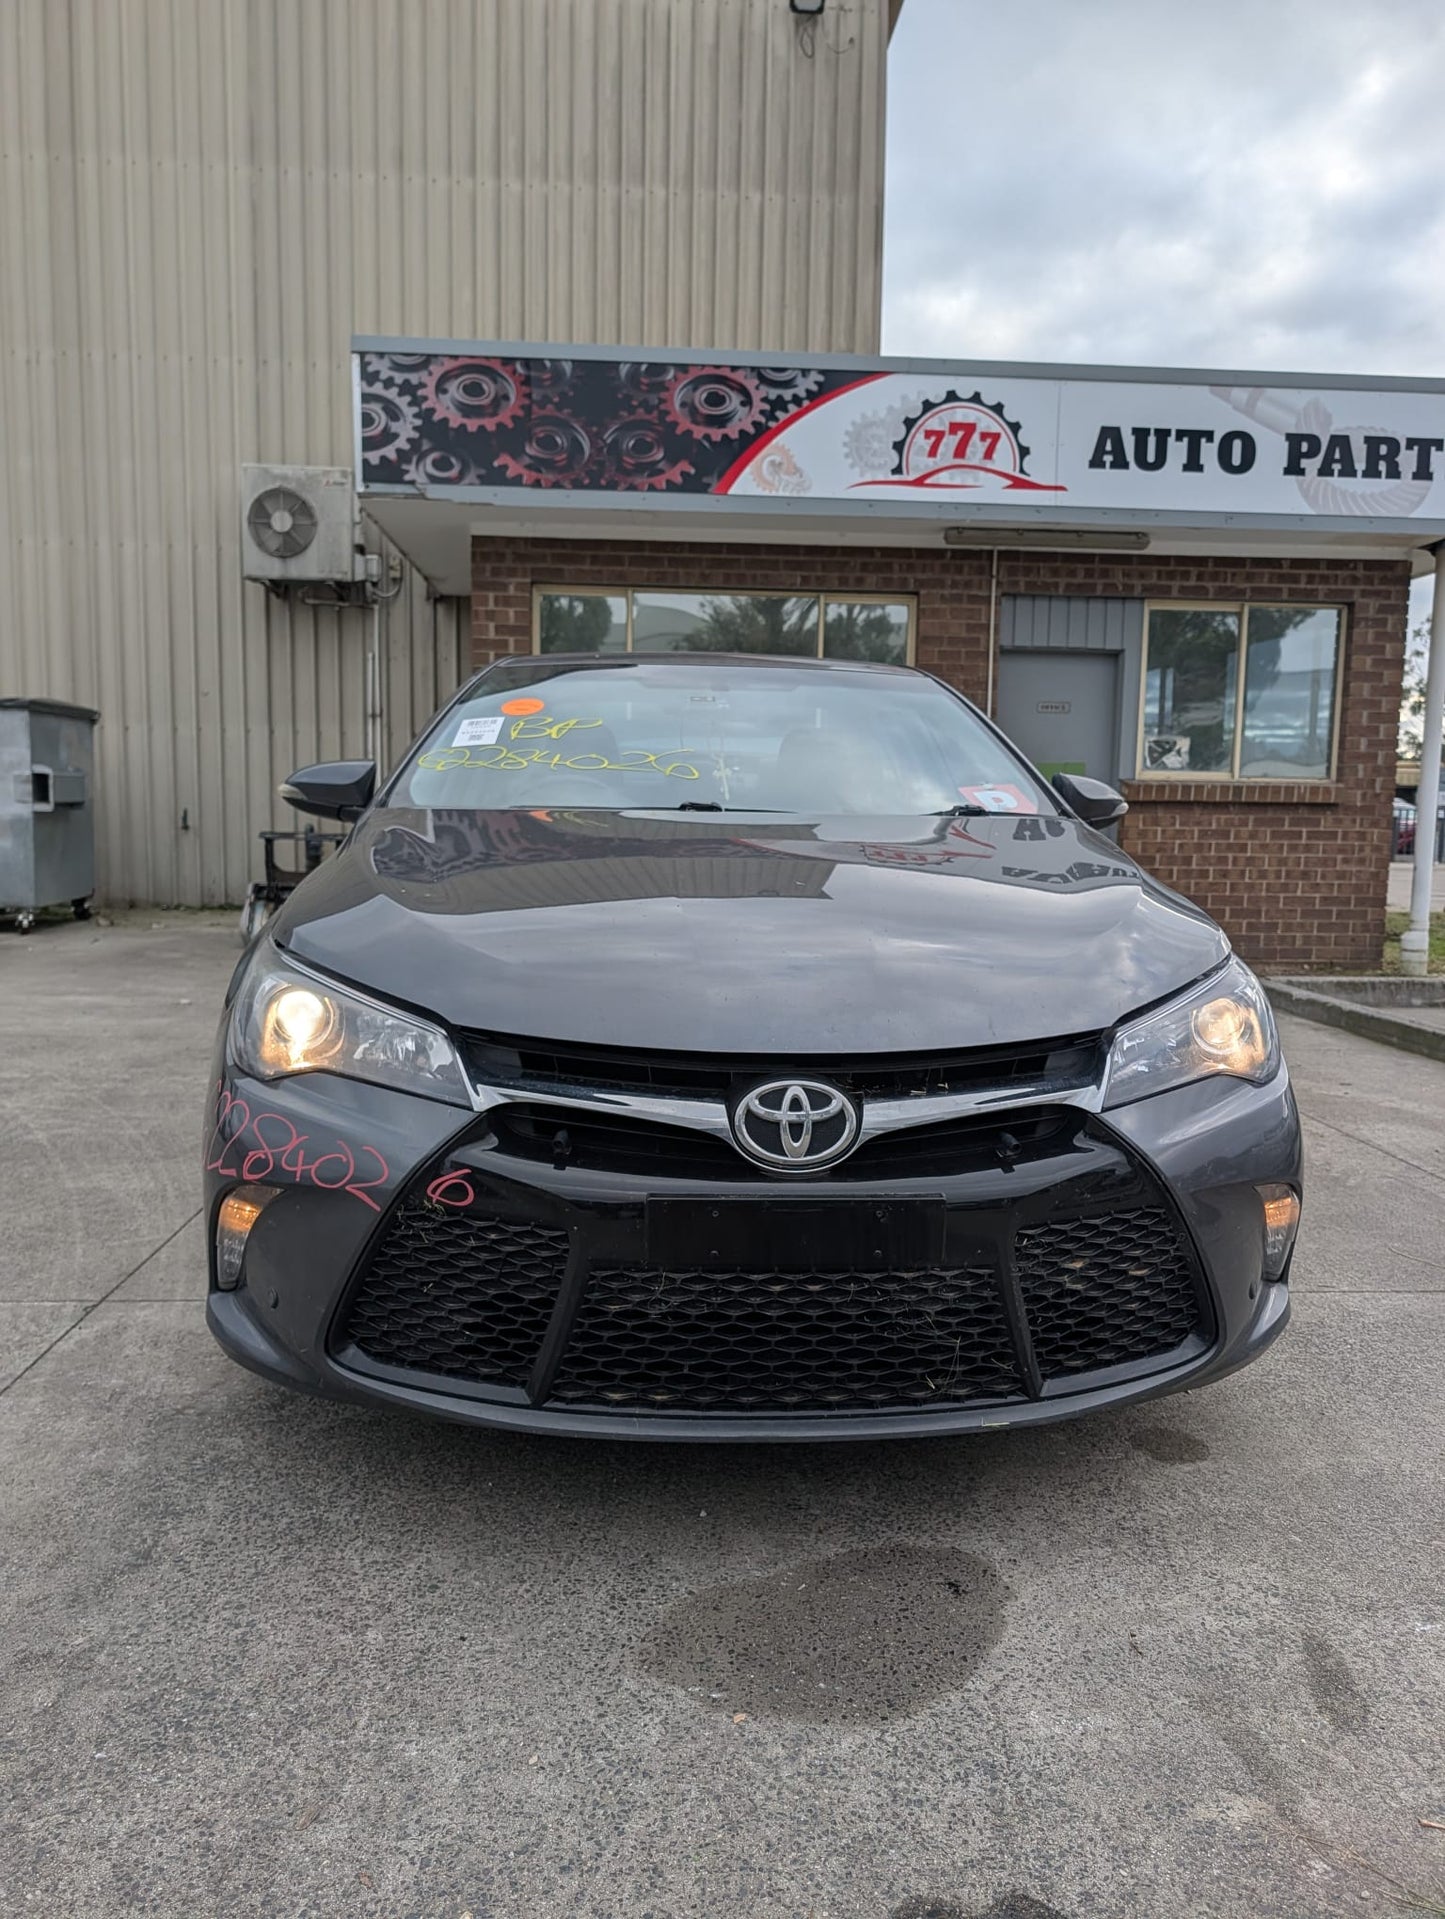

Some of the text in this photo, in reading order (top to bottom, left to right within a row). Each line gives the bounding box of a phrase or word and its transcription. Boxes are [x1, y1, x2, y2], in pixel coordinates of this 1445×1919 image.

[924, 421, 1001, 461] 777
[1088, 425, 1444, 482] AUTO PART
